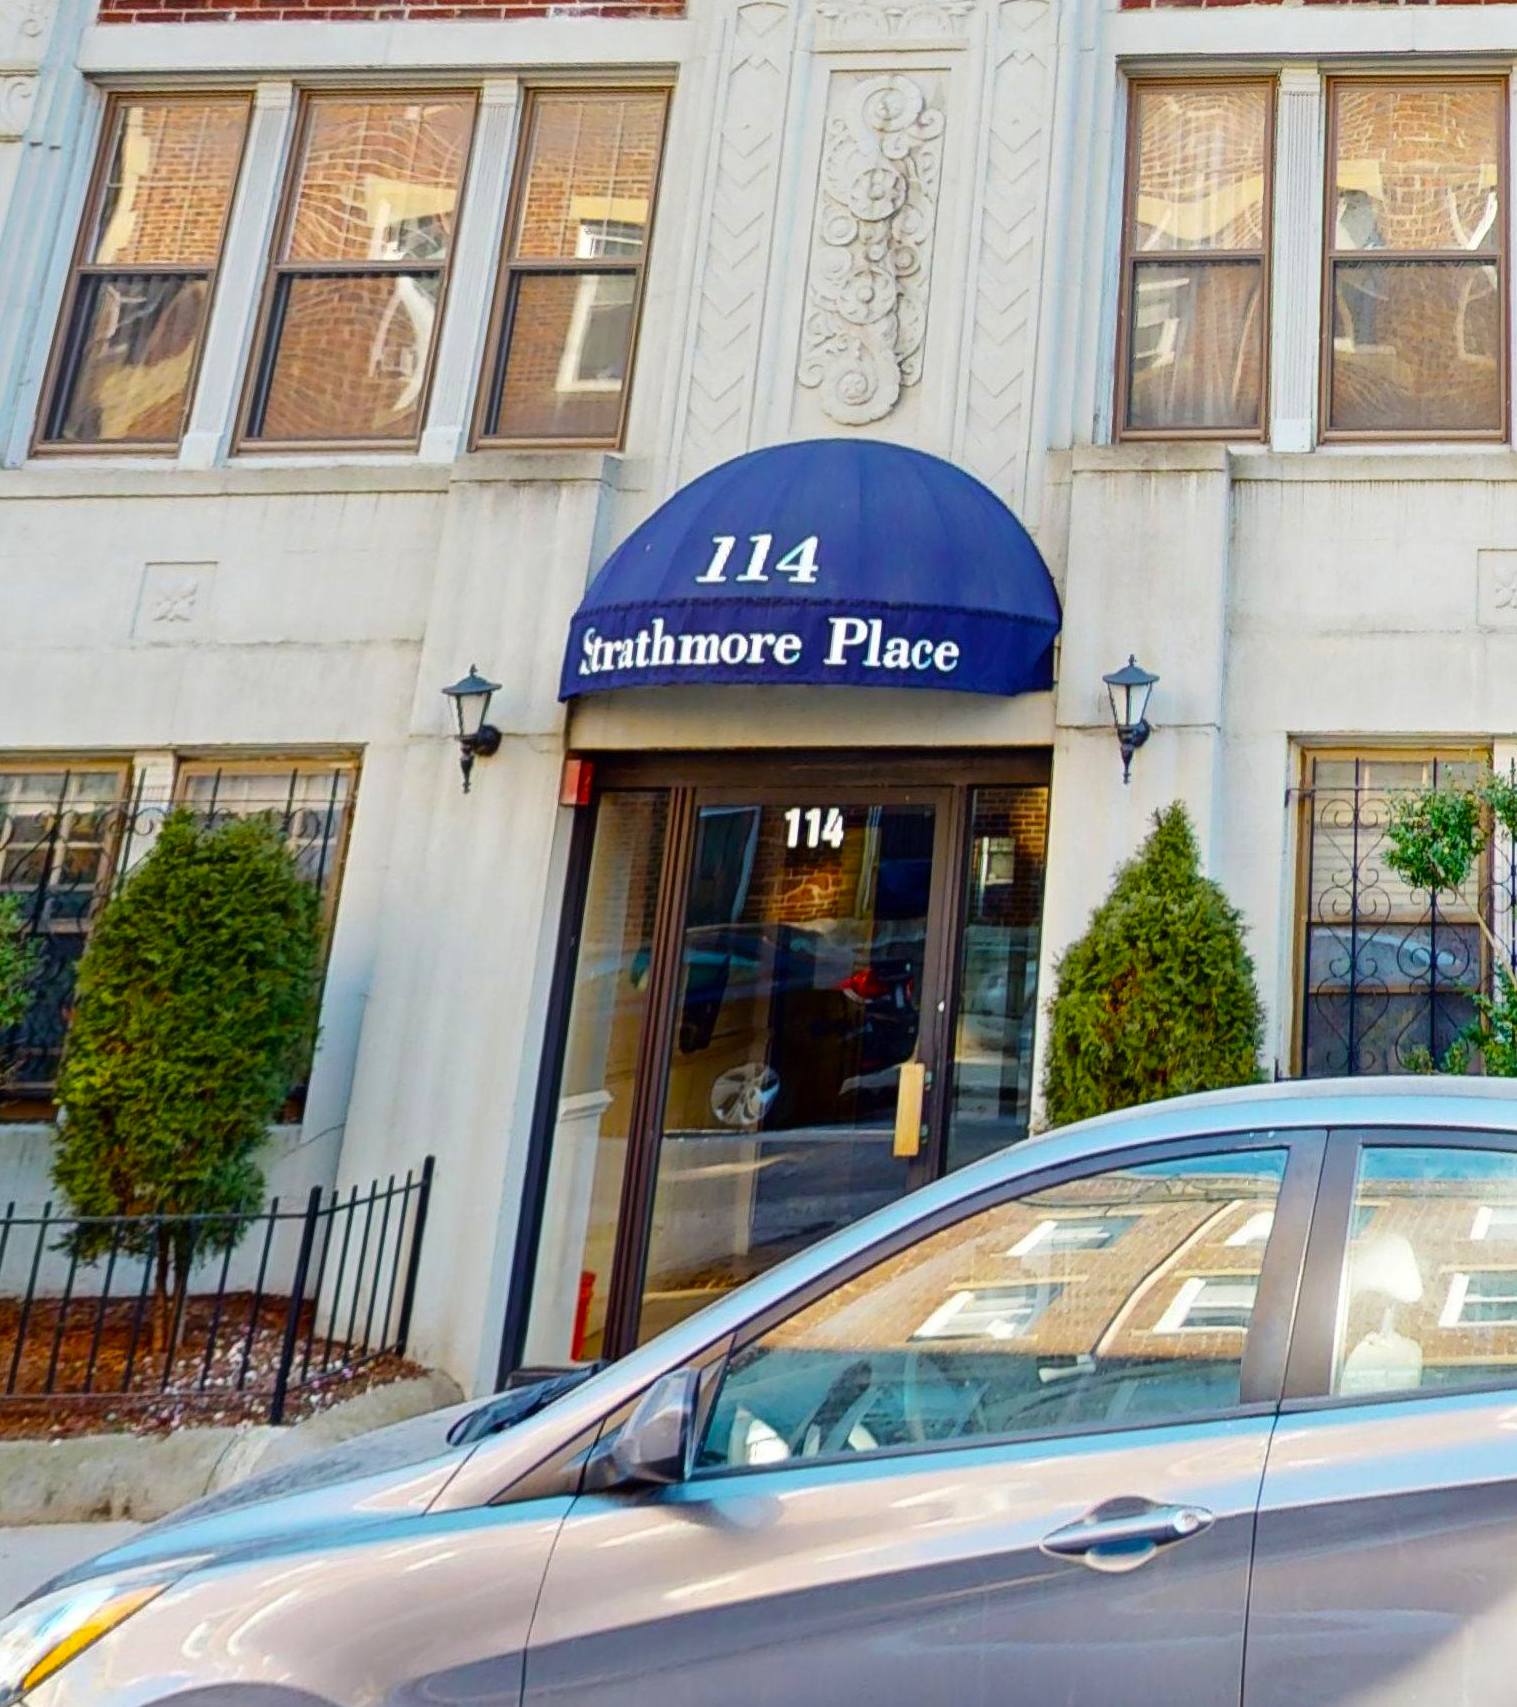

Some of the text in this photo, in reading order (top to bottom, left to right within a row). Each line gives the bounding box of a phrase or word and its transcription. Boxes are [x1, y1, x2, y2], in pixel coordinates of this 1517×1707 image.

[695, 533, 820, 584] 114
[578, 616, 960, 676] Strathmore Place
[784, 807, 845, 849] 114
